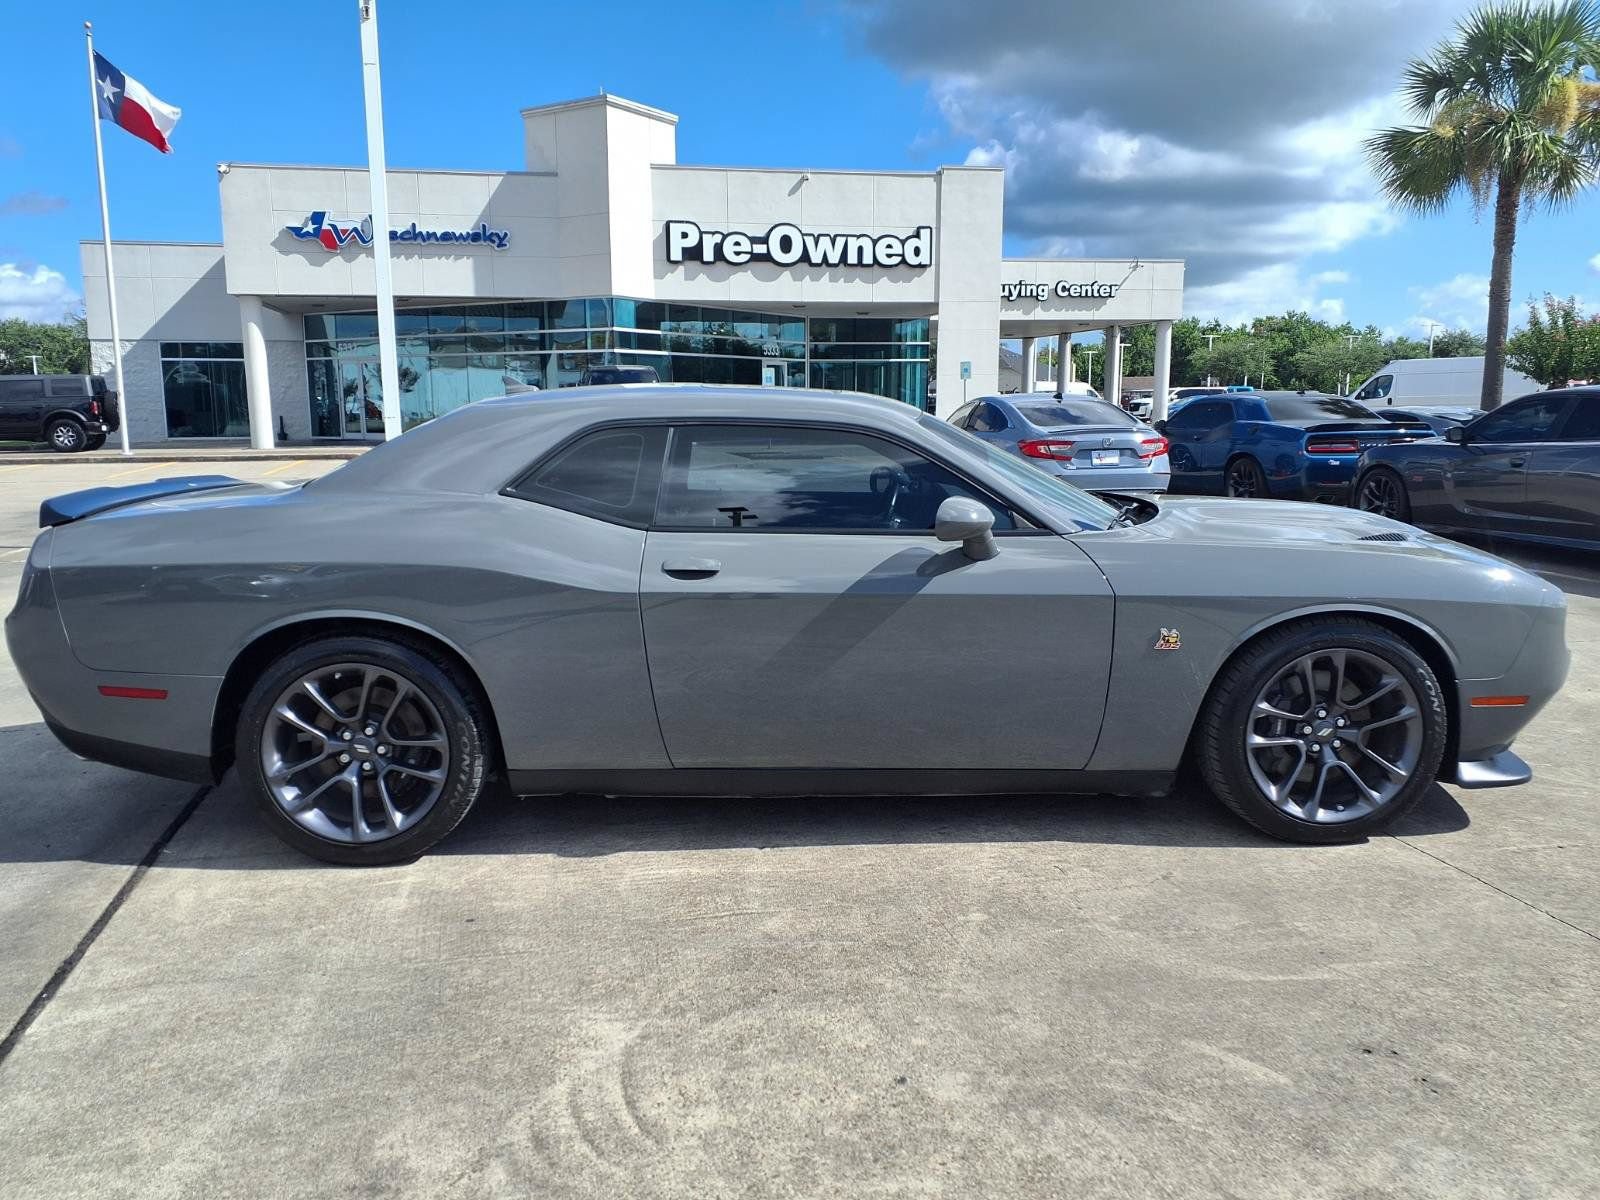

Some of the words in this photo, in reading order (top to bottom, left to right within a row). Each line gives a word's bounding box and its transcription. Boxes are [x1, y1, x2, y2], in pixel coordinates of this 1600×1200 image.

[666, 220, 932, 267] Pre-Owned
[1000, 280, 1049, 301] uying
[1055, 280, 1119, 299] Center
[763, 345, 780, 356] 5333
